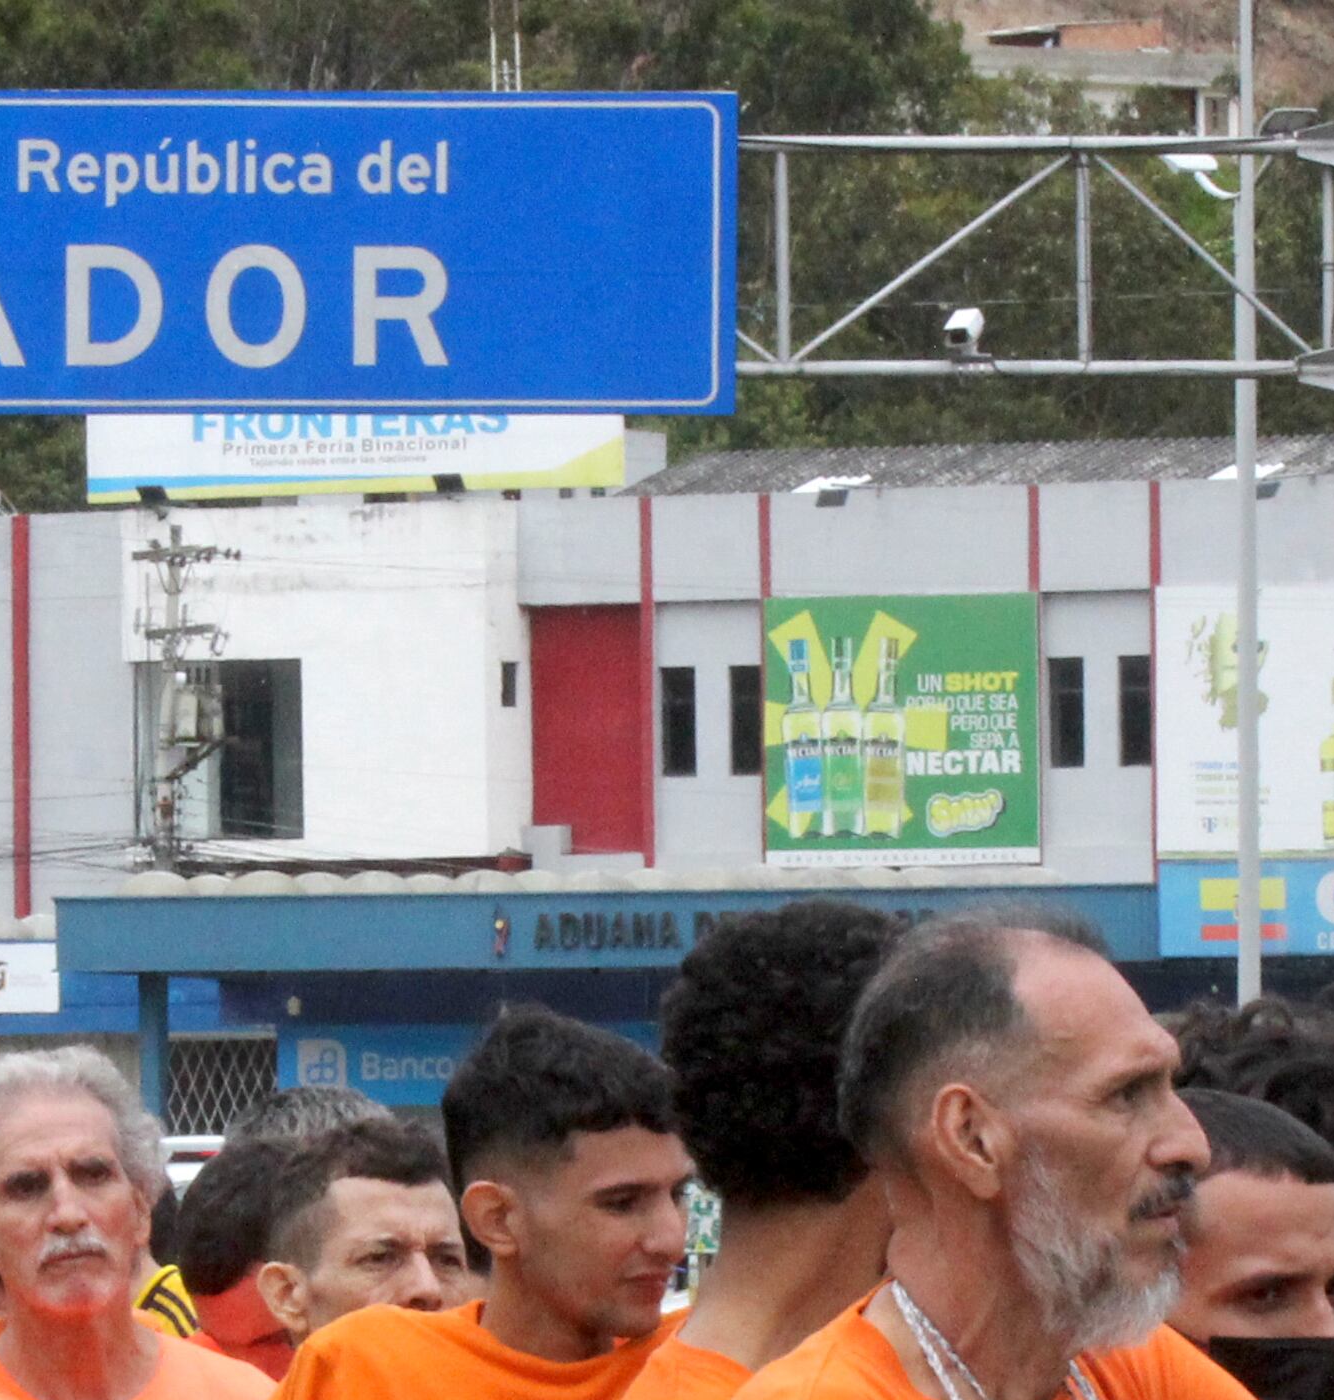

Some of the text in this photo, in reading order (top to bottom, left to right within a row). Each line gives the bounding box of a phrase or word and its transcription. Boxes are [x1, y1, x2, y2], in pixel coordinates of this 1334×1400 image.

[18, 137, 333, 208] República
[357, 138, 448, 195] del
[192, 413, 510, 442] FRONTERAS
[222, 436, 467, 456] Primera Feria Binacional
[916, 670, 1019, 693] UN SHOT
[988, 693, 1019, 711] SEA
[950, 714, 988, 731] PERO
[1008, 731, 1020, 748] A
[906, 749, 1022, 776] NECTAR
[533, 911, 682, 951] ADUANA
[361, 1052, 455, 1081] Banco
